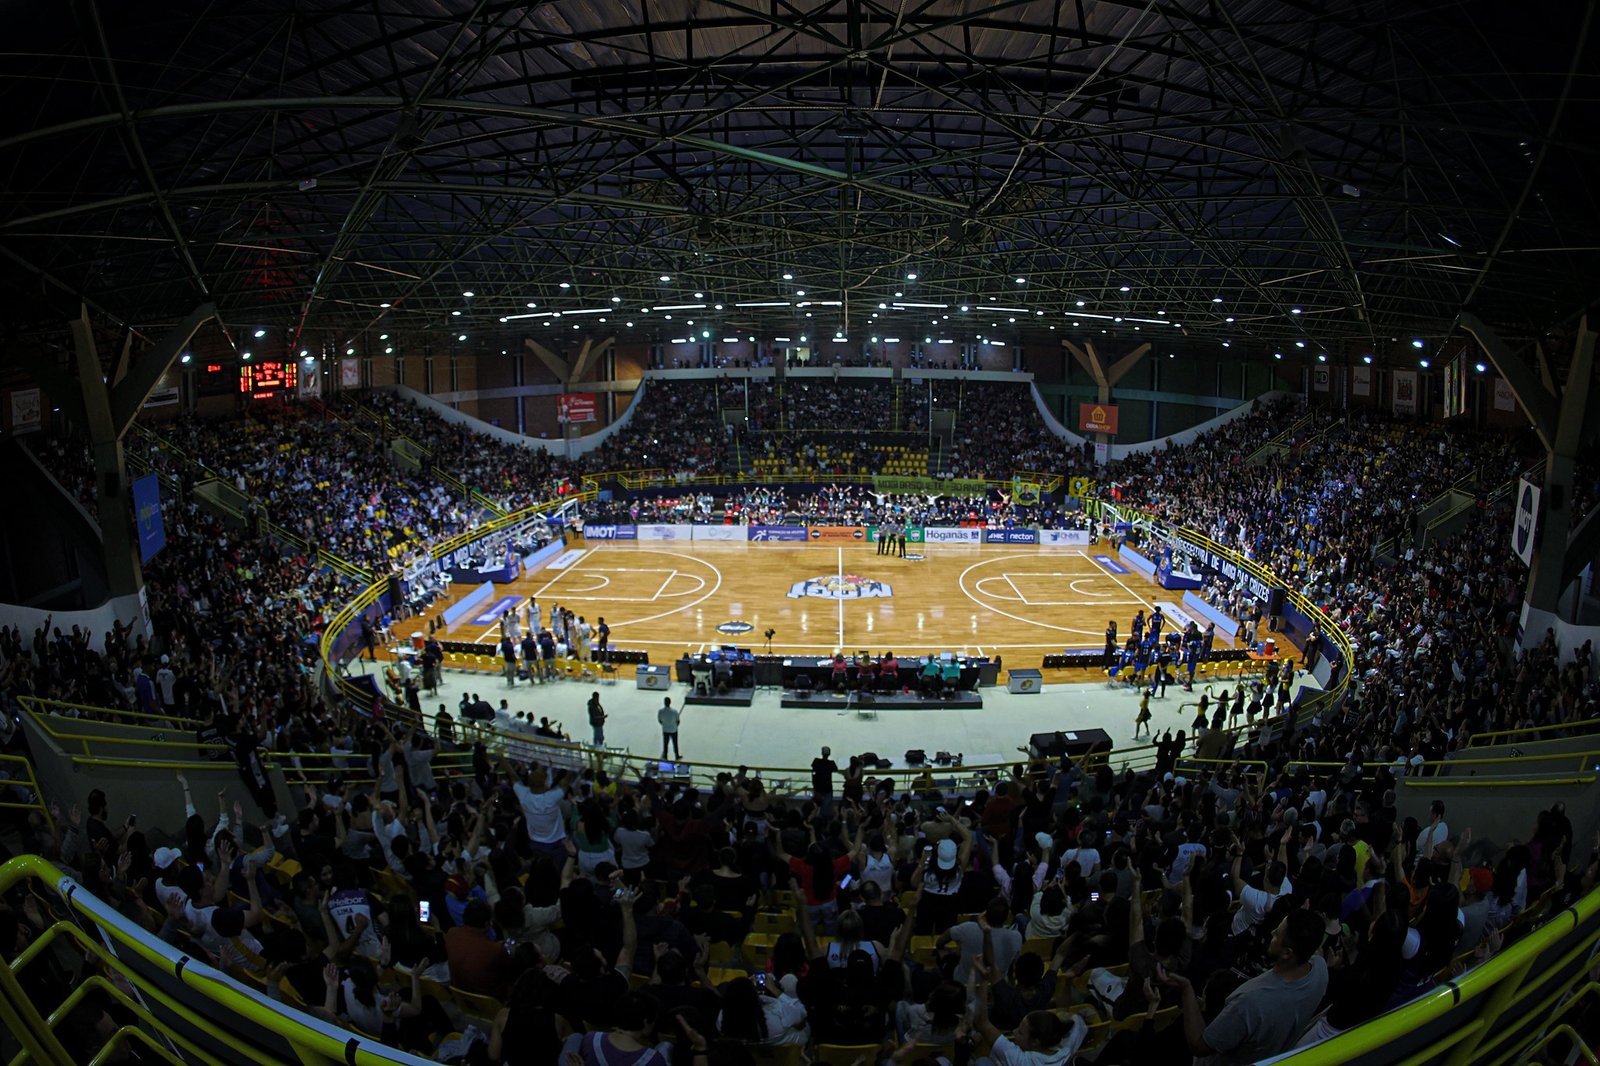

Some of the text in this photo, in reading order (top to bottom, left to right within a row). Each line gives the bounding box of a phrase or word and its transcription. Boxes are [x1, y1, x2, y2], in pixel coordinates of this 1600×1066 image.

[900, 480, 944, 491] BASQUETE
[963, 482, 986, 493] ANOS
[926, 530, 968, 541] Höganäs
[1009, 533, 1034, 541] necton
[1211, 555, 1220, 570] DE
[1222, 560, 1237, 580] MOGI
[1249, 577, 1270, 603] CRUZES
[337, 907, 354, 916] LIMA
